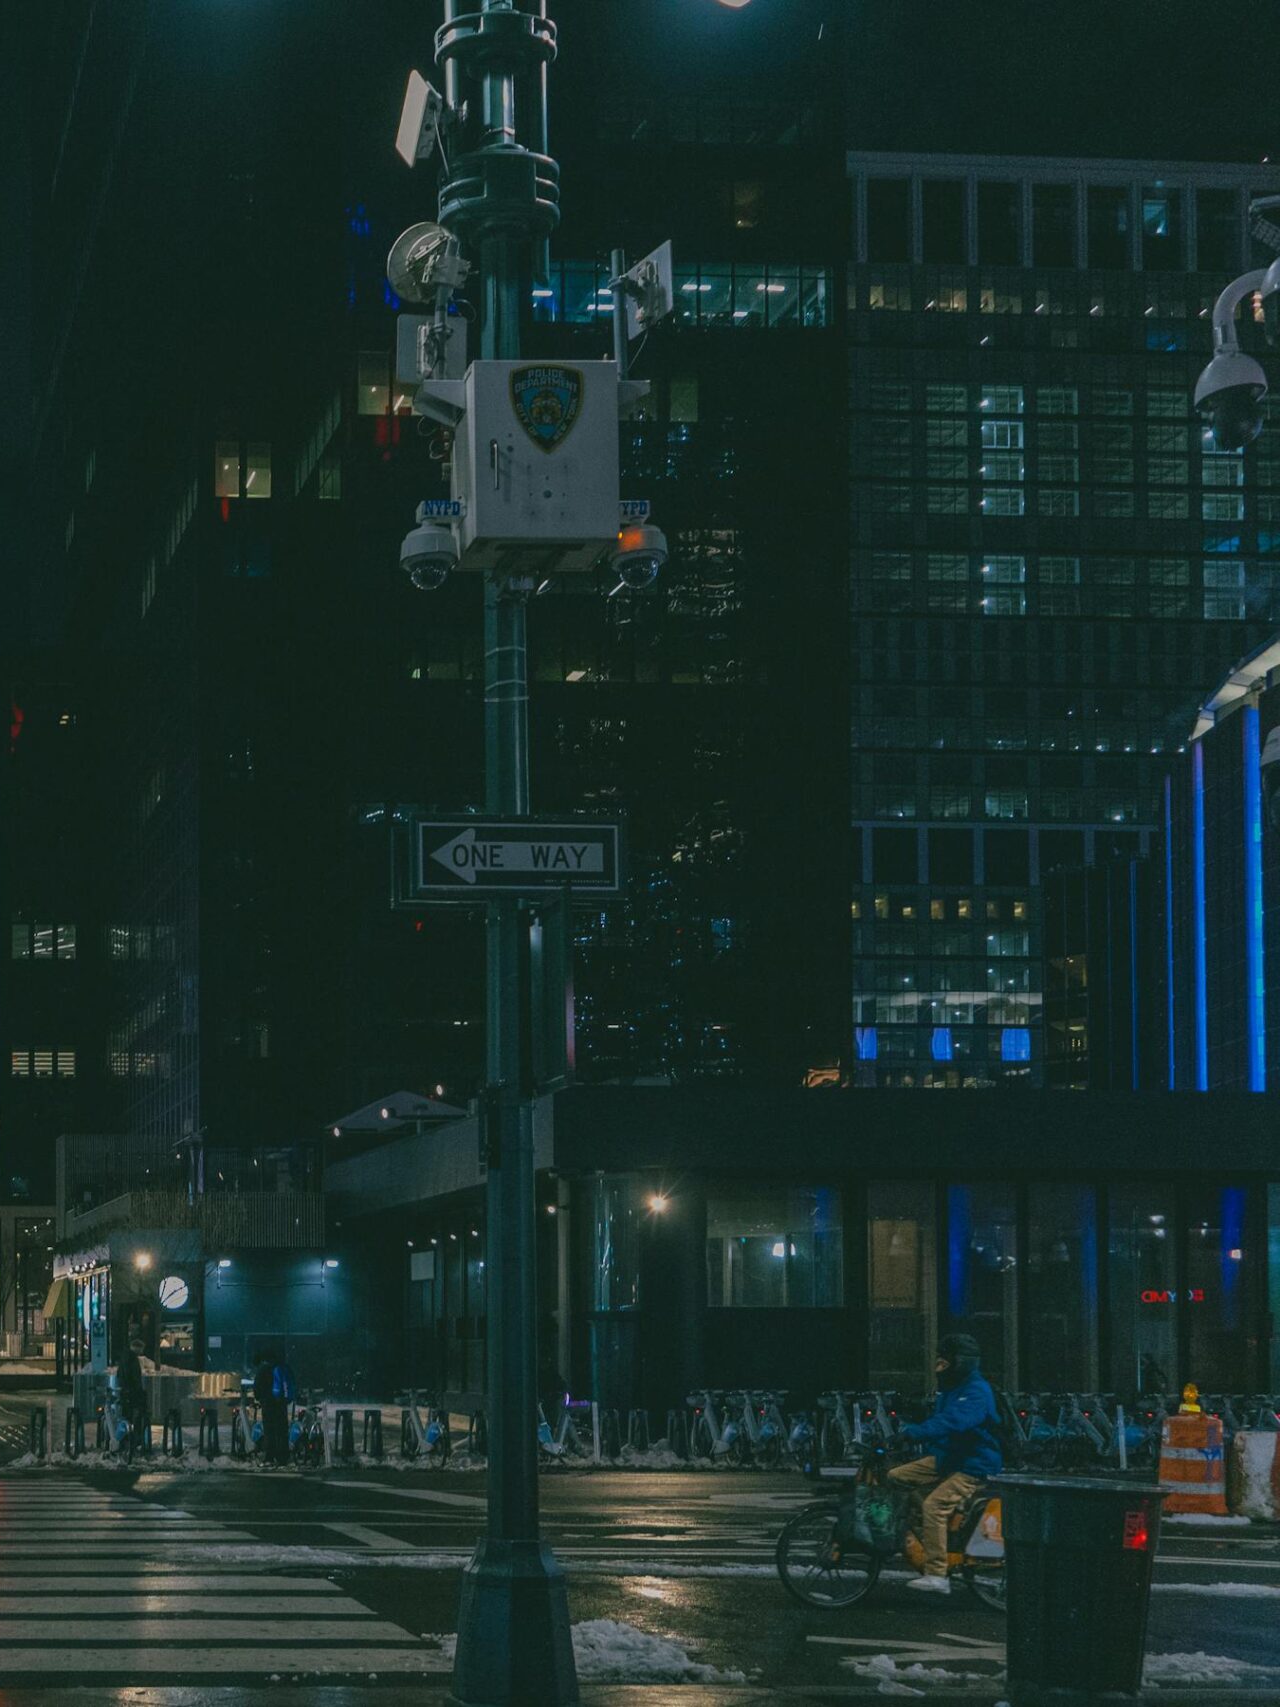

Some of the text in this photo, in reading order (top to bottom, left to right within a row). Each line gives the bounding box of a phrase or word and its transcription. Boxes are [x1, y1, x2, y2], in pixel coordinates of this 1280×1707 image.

[527, 368, 565, 379] POLICE
[515, 377, 578, 393] DEPARTMENT
[424, 500, 461, 516] NYPD
[621, 501, 648, 515] YPD
[452, 844, 588, 869] ONE WAY
